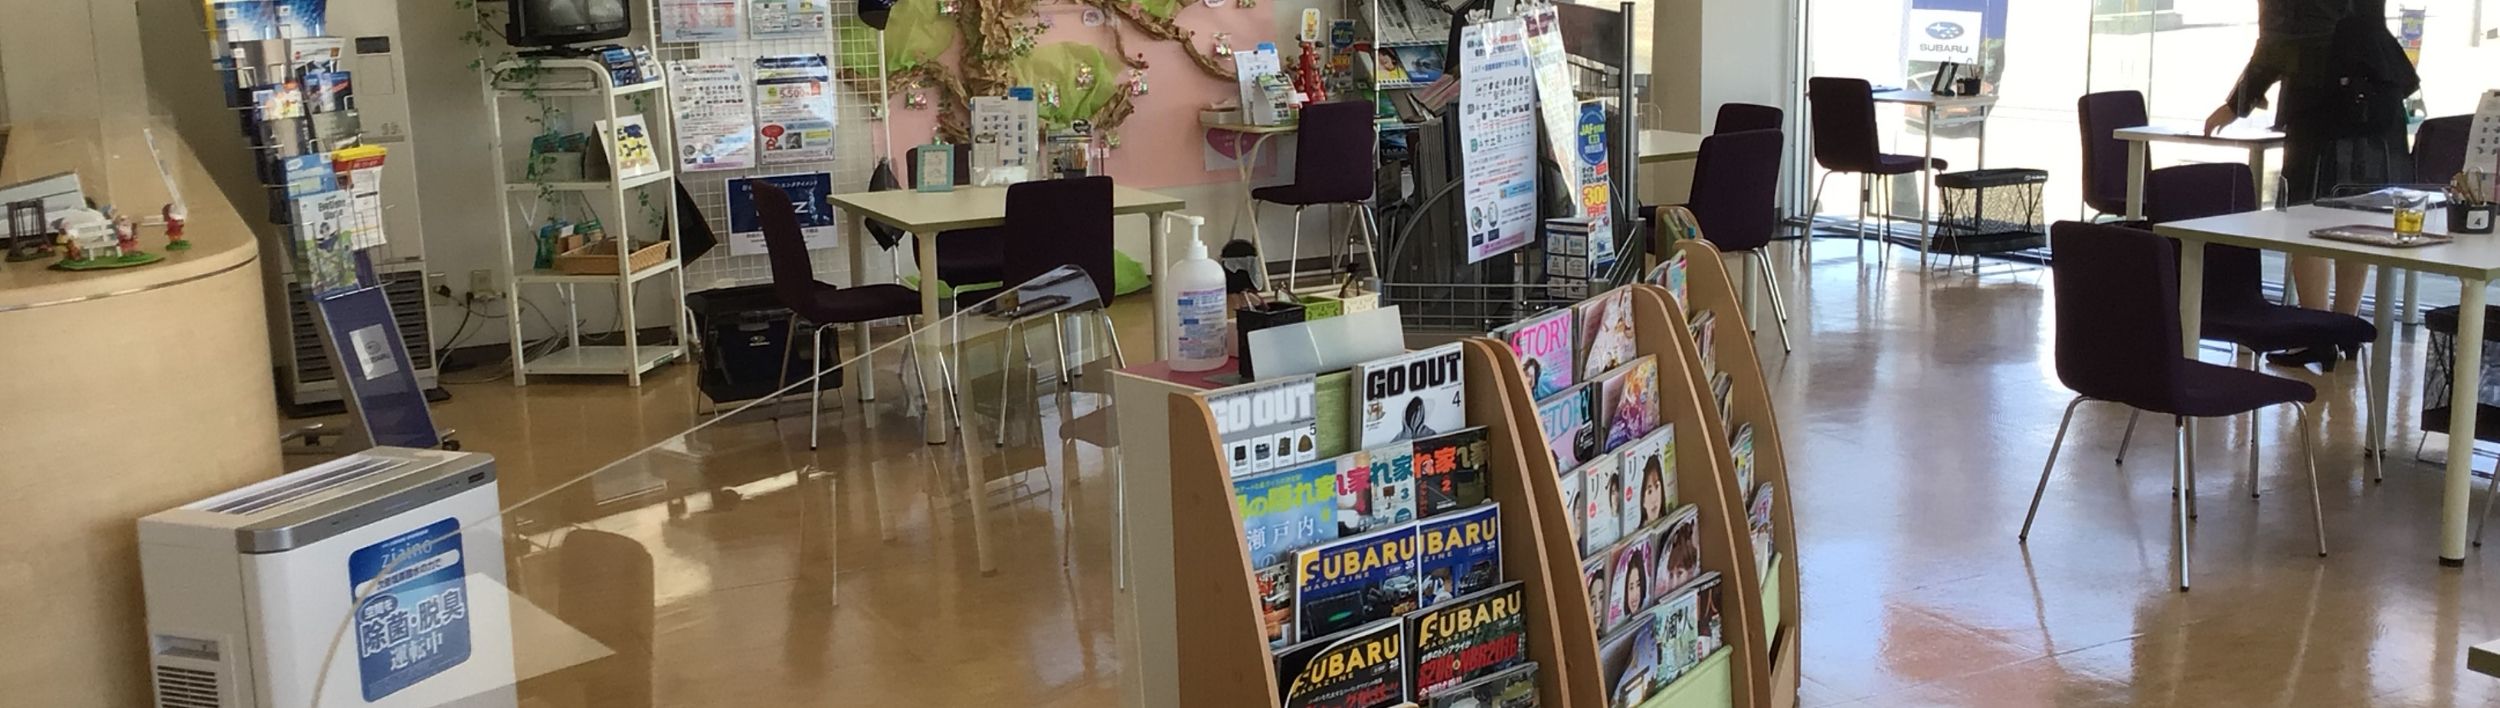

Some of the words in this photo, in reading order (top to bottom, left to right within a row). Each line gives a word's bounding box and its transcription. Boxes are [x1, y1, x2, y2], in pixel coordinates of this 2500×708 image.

[1919, 43, 1969, 53] SUBARU
[1583, 183, 1608, 207] 300
[2473, 217, 2482, 226] 4
[1510, 313, 1571, 358] STORY
[1366, 368, 1406, 402] GO
[1408, 350, 1462, 392] OUT
[1252, 383, 1315, 428] OUT
[1452, 390, 1462, 408] 4
[1309, 422, 1317, 436] 5
[1400, 488, 1410, 500] 3
[1441, 479, 1452, 493] 2
[380, 538, 433, 569] ziaino
[1300, 535, 1415, 587] SUBARU
[1423, 550, 1454, 564] ZINE
[1303, 571, 1370, 593] MAGAZINE
[360, 588, 466, 659] 除菌・脱臭
[1418, 590, 1521, 649] SUBARU
[1423, 627, 1481, 651] MAGAZINE
[390, 631, 444, 672] 運転中
